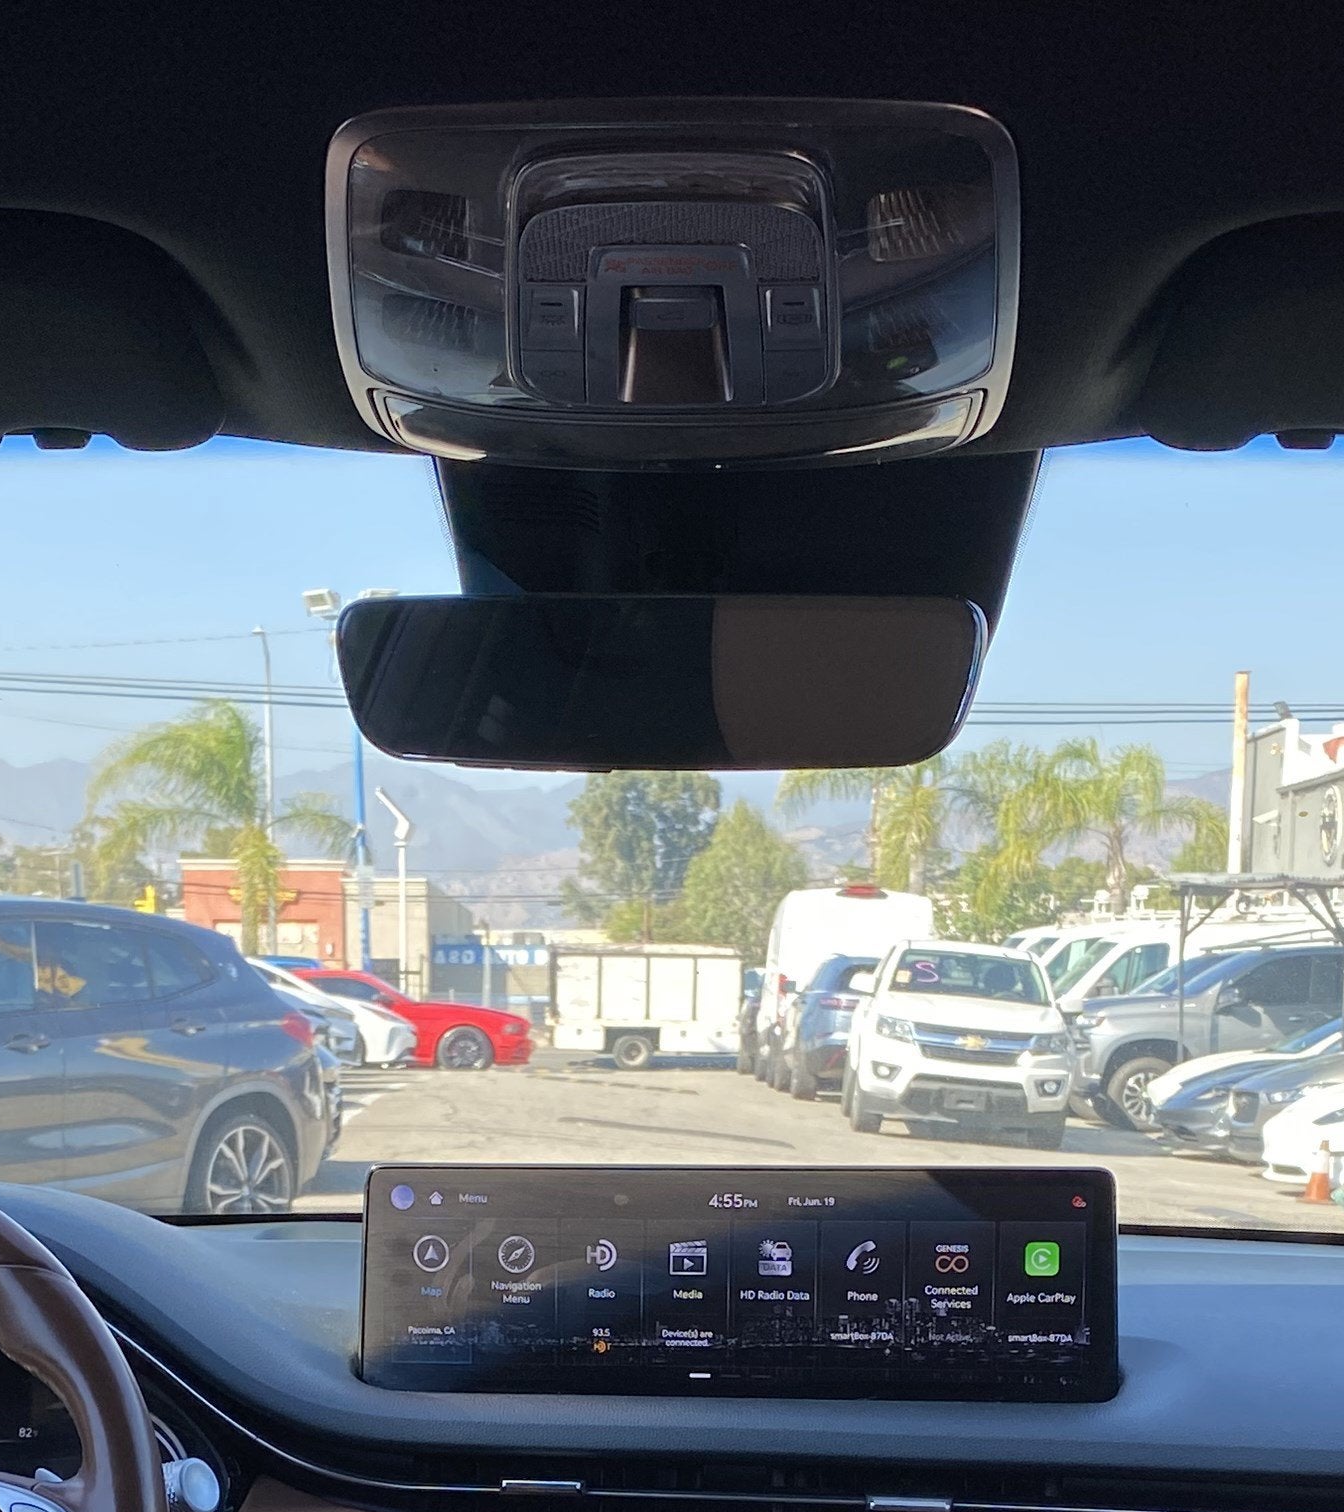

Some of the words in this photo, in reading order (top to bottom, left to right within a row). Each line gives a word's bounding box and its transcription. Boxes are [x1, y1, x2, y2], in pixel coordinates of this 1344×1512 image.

[458, 1193, 488, 1204] Menu
[823, 1196, 835, 1206] 19
[935, 1244, 970, 1253] GENESIS
[421, 1286, 443, 1299] Map
[491, 1280, 542, 1293] Navigation
[924, 1285, 979, 1297] Connected
[502, 1293, 530, 1305] Menu
[588, 1287, 616, 1299] Radio
[673, 1288, 703, 1300] Media
[740, 1289, 756, 1301] HD
[757, 1289, 785, 1301] Radio
[786, 1290, 810, 1301] Data
[847, 1290, 878, 1302] Phone
[1006, 1292, 1035, 1305] Apple
[1037, 1292, 1076, 1305] CarPlay
[930, 1298, 972, 1310] Services
[443, 1325, 456, 1335] CA
[592, 1328, 611, 1337] 93.5
[662, 1329, 696, 1340] Device(s)
[697, 1331, 713, 1339] are
